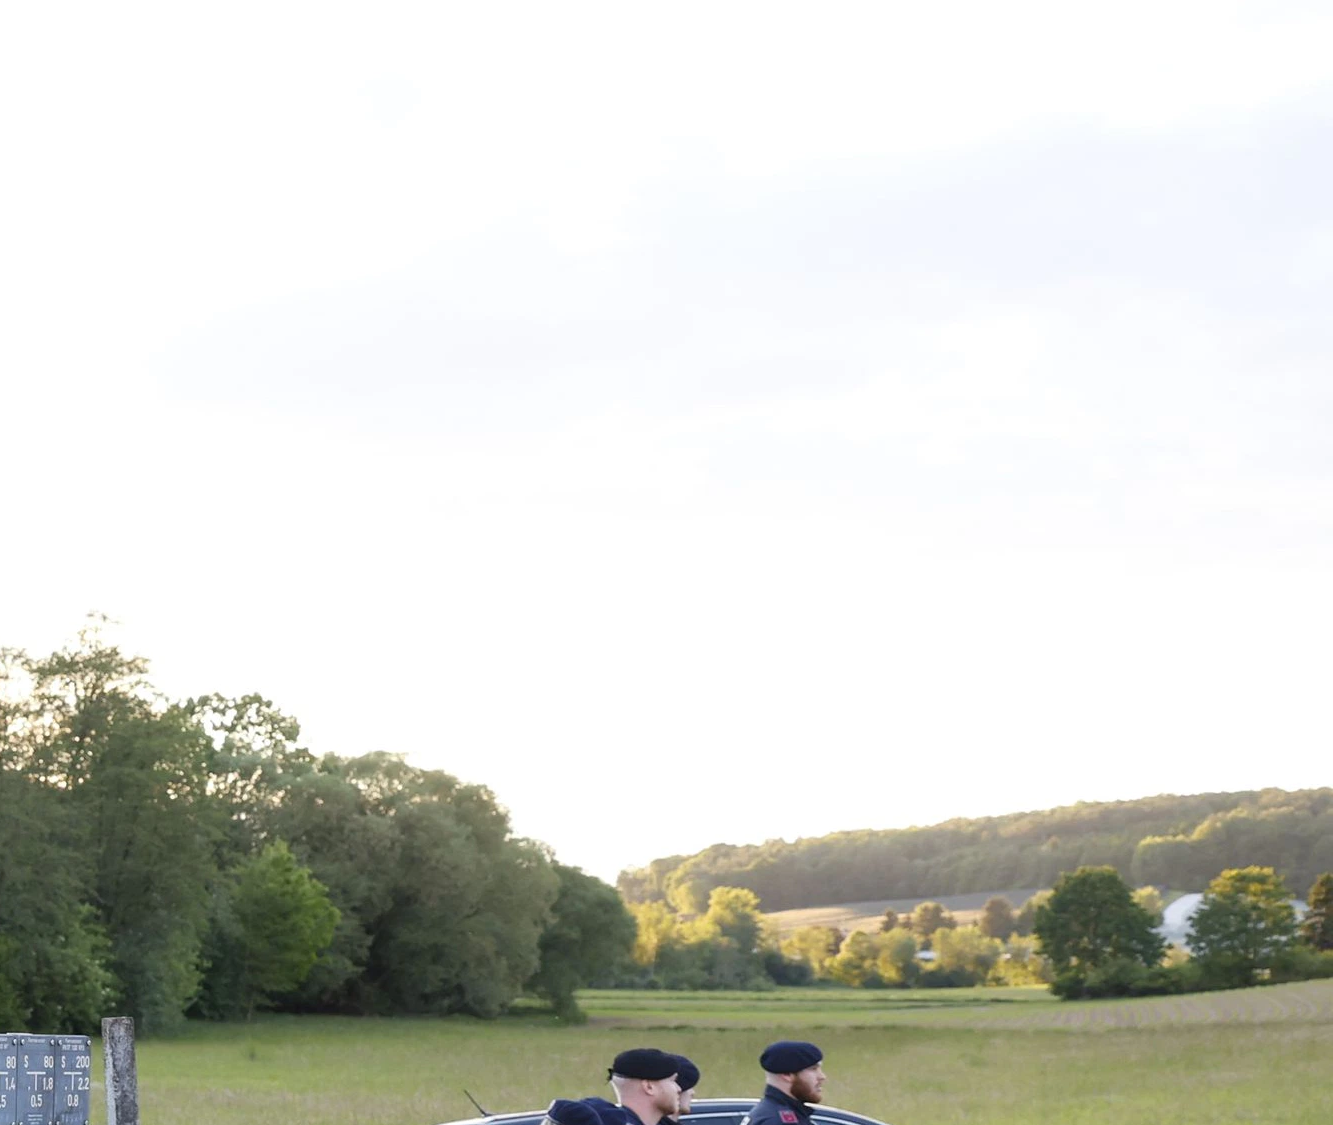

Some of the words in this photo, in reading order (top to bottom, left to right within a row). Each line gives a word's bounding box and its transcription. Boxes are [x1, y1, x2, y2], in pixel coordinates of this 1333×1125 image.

[6, 1055, 17, 1069] 80
[24, 1055, 30, 1068] S
[43, 1055, 54, 1069] 80
[61, 1056, 67, 1068] S
[75, 1055, 90, 1069] 200
